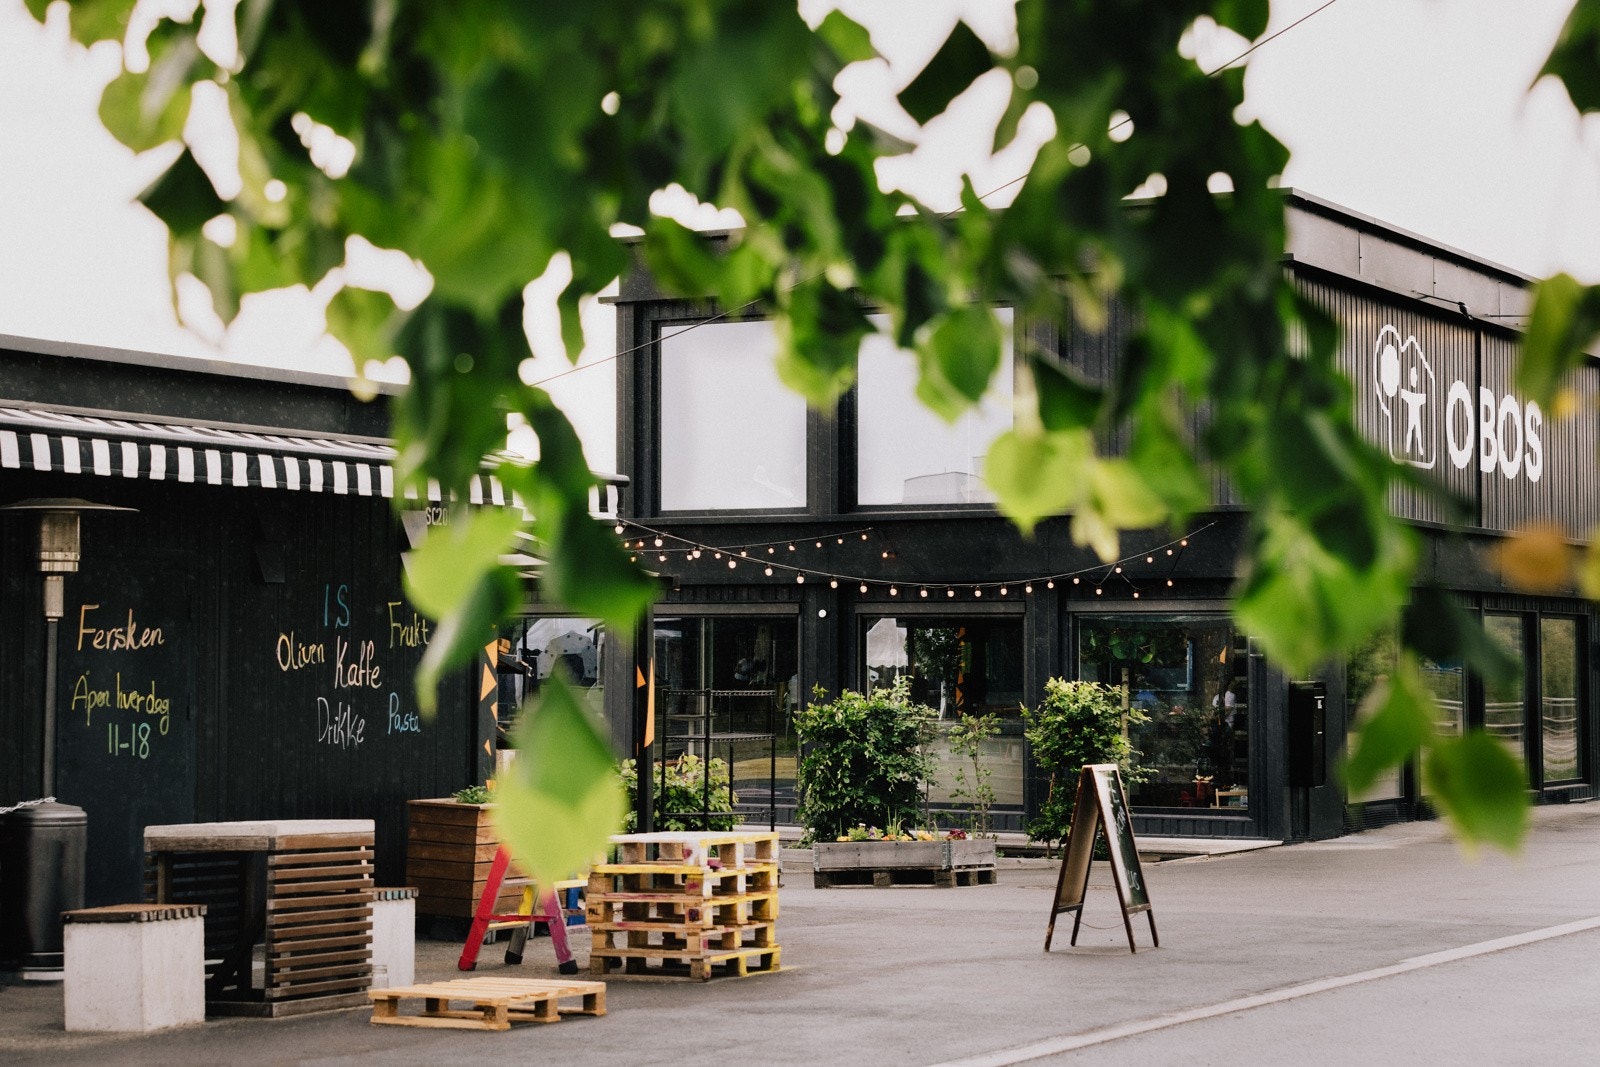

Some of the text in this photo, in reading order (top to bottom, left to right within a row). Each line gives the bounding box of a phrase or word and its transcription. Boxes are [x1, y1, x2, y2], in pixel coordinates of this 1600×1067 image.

[1446, 380, 1543, 483] OBOS
[77, 604, 165, 651] Fersken
[323, 583, 350, 629] IS
[387, 601, 430, 649] Frukt
[276, 630, 325, 672] Oliven
[334, 635, 382, 690] Kaffe
[71, 670, 111, 726] Åpen
[388, 691, 421, 735] Pasta
[108, 722, 151, 760] 11-18
